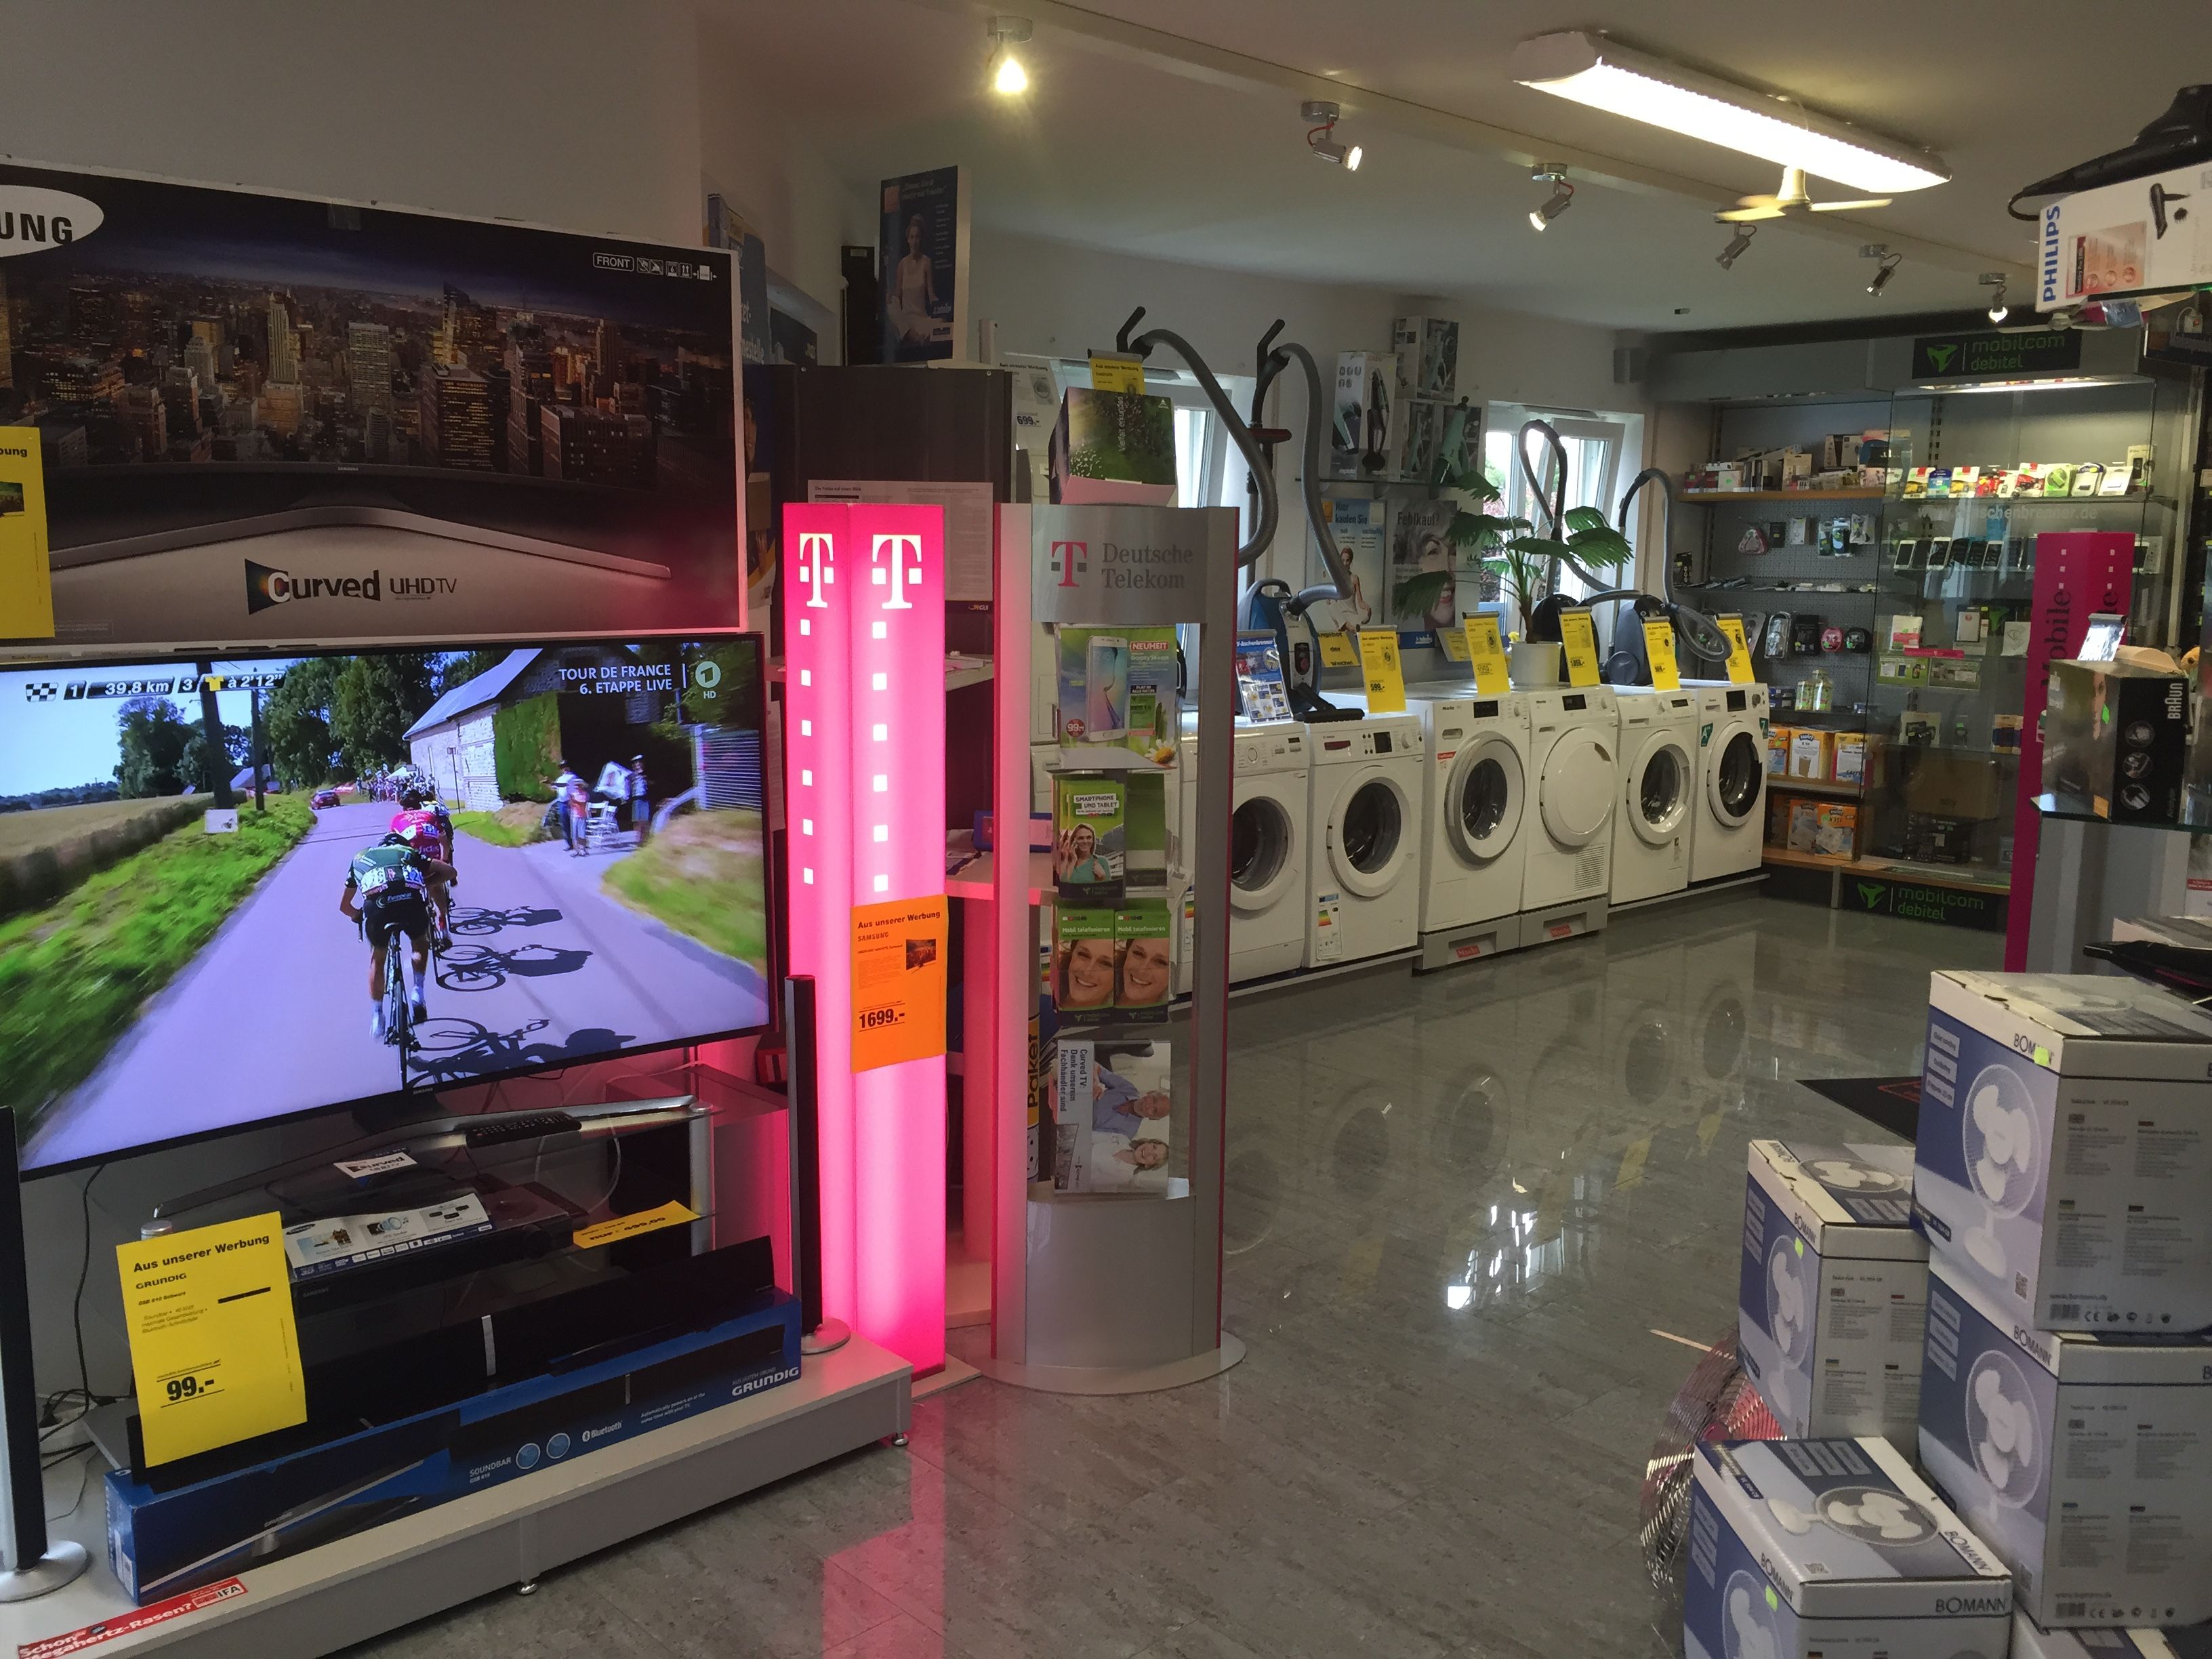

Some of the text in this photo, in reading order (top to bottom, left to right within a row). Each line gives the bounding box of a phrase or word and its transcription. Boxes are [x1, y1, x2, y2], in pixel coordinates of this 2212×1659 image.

[596, 255, 630, 268] FRONT
[2043, 205, 2060, 302] PHILIPS
[1972, 334, 2065, 352] mobilcom
[1971, 354, 2024, 371] debitel
[1397, 512, 1439, 527] Fehlkauf?
[1051, 541, 1088, 587] T
[1102, 543, 1193, 564] Deutsche
[800, 533, 834, 608] T
[872, 534, 922, 609] T
[1102, 569, 1185, 589] Telekom
[268, 569, 381, 602] Curved
[1132, 642, 1167, 651] NEUHEIT
[558, 664, 671, 680] TOUR DE FRANCE
[70, 684, 78, 697] 1
[105, 680, 142, 696] 39,8
[146, 680, 169, 693] km
[182, 679, 193, 691] 3
[228, 675, 237, 689] à
[579, 679, 672, 695] 6. ETAPPE LIVE
[703, 691, 716, 699] HD
[2165, 682, 2184, 720] BRAUN
[1898, 885, 1984, 910] mobilcom
[875, 917, 905, 927] unserer
[907, 912, 941, 922] Werbung
[1898, 902, 1946, 920] debitel
[857, 932, 889, 941] SAMSUNG
[859, 1008, 905, 1029] 1699.-
[1028, 1034, 1038, 1108] Paket
[1080, 1049, 1088, 1076] Curved
[134, 1235, 270, 1273] Aus unserer Werbung
[136, 1273, 187, 1289] GRUNDIG
[2013, 1326, 2053, 1366] BOMANN
[167, 1376, 214, 1401] 99.-
[732, 1366, 800, 1396] GRUNDIG
[591, 1420, 623, 1438] Bluetooth
[469, 1456, 512, 1477] SOUNDBAR
[1944, 1530, 1994, 1572] BOMANN
[1761, 1552, 1793, 1602] BOMANN
[217, 1586, 241, 1597] IFA
[1936, 1597, 2007, 1614] BOMANN
[20, 1635, 78, 1658] Schon
